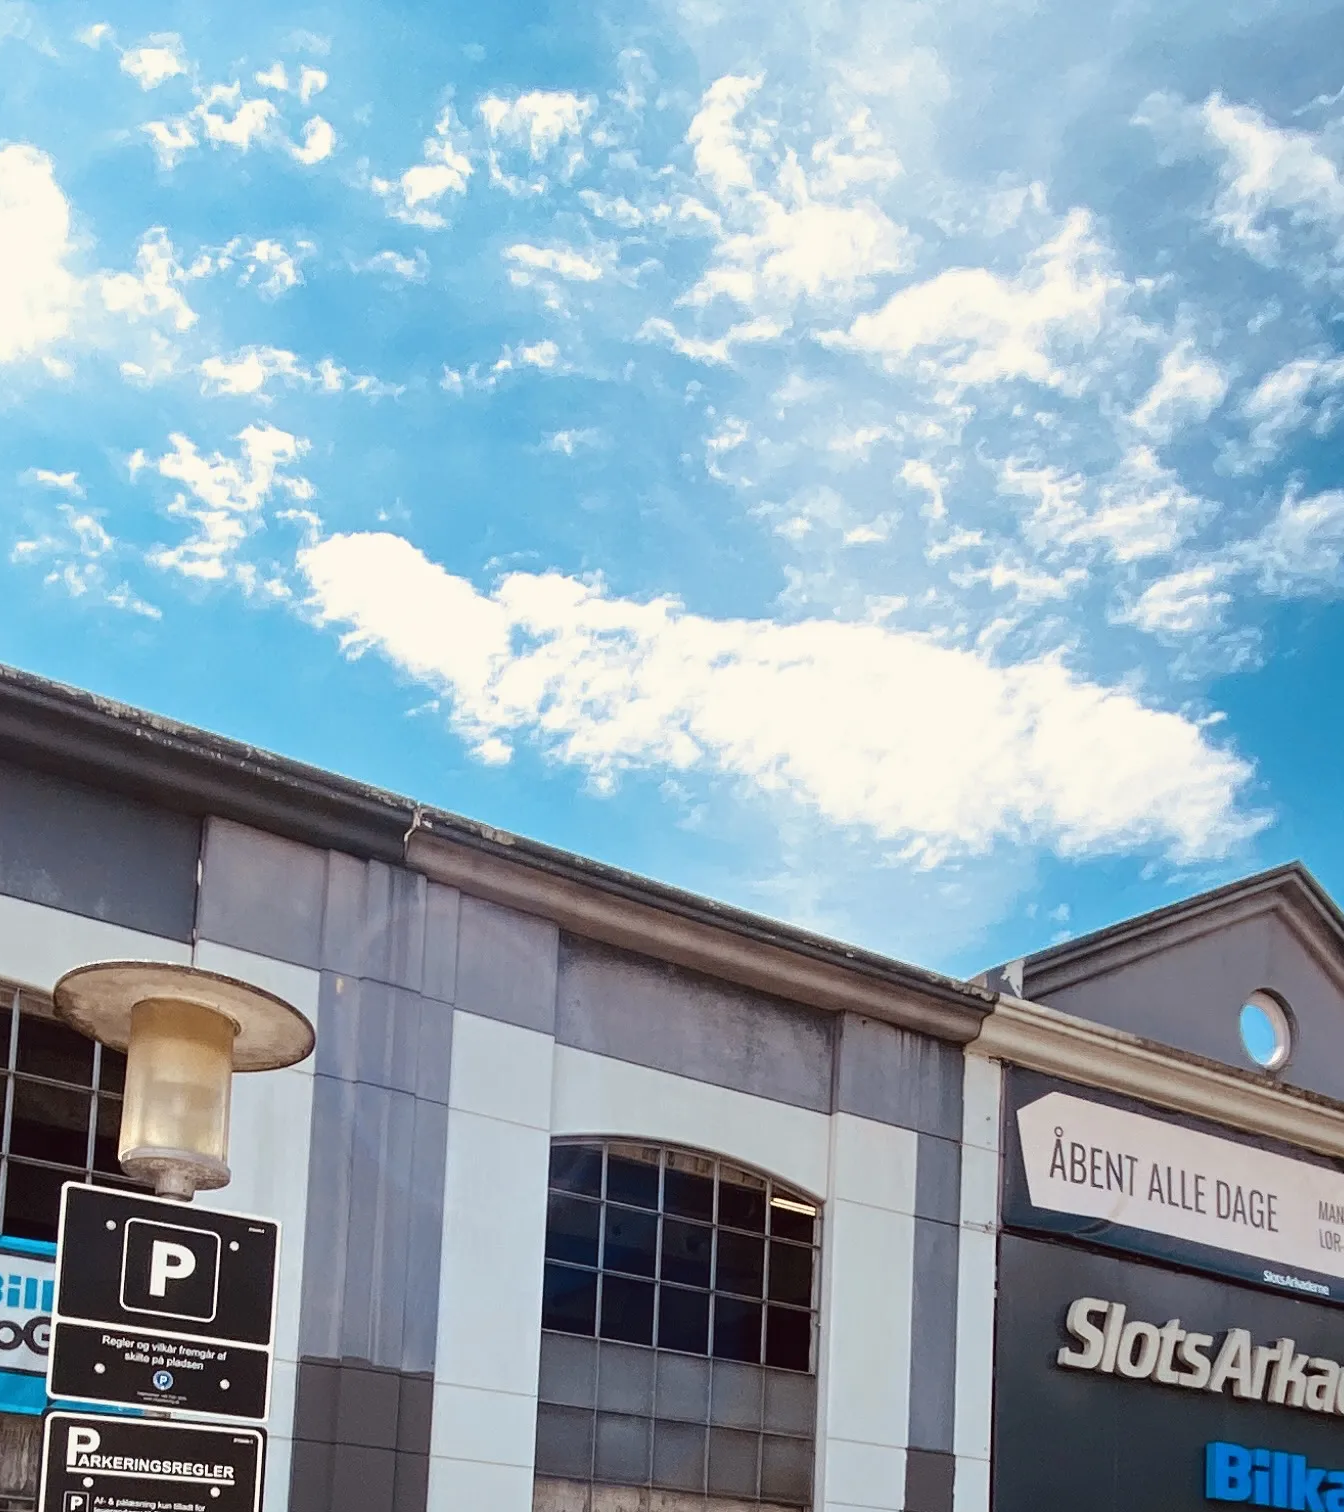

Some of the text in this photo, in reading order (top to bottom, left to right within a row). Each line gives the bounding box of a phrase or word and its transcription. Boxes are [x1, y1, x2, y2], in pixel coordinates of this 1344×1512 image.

[1049, 1126, 1279, 1233] ÅBENT ALLE DAGE
[149, 1239, 197, 1298] P
[102, 1334, 227, 1361] Regler og vilkår fremgår af
[124, 1351, 204, 1370] skilte på pladsen
[66, 1426, 234, 1478] PARKERINGSREGLER
